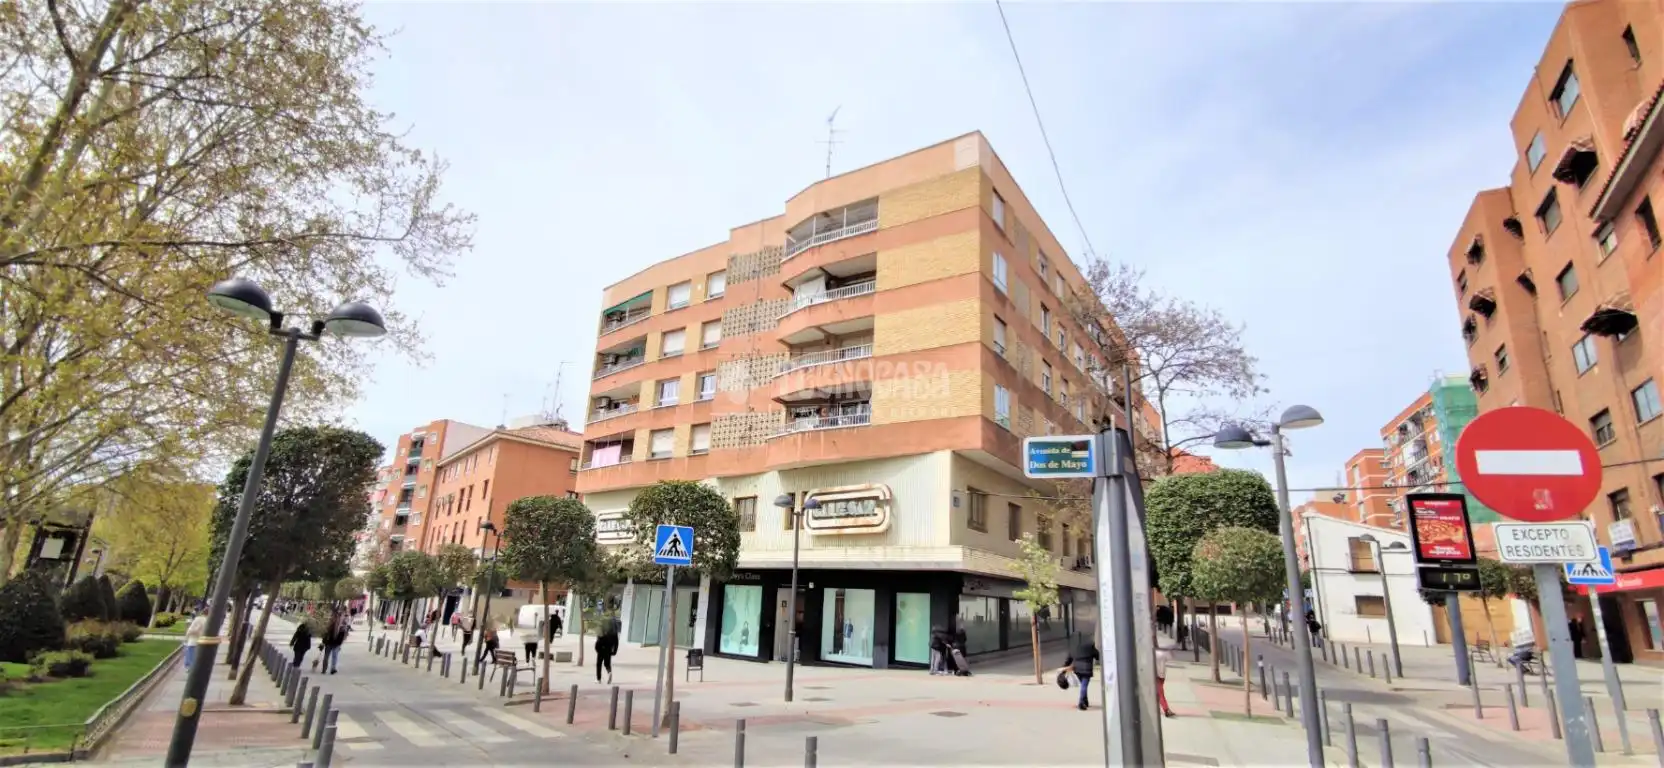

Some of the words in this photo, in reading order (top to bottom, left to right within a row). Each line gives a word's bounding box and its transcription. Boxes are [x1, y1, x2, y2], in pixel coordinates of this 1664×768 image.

[1030, 447, 1060, 455] Avenida
[1030, 460, 1046, 469] Dos
[1048, 460, 1060, 468] de
[1061, 459, 1088, 470] Mayo
[1512, 528, 1569, 541] EXCEPTO
[1505, 544, 1585, 557] RESIDENTES
